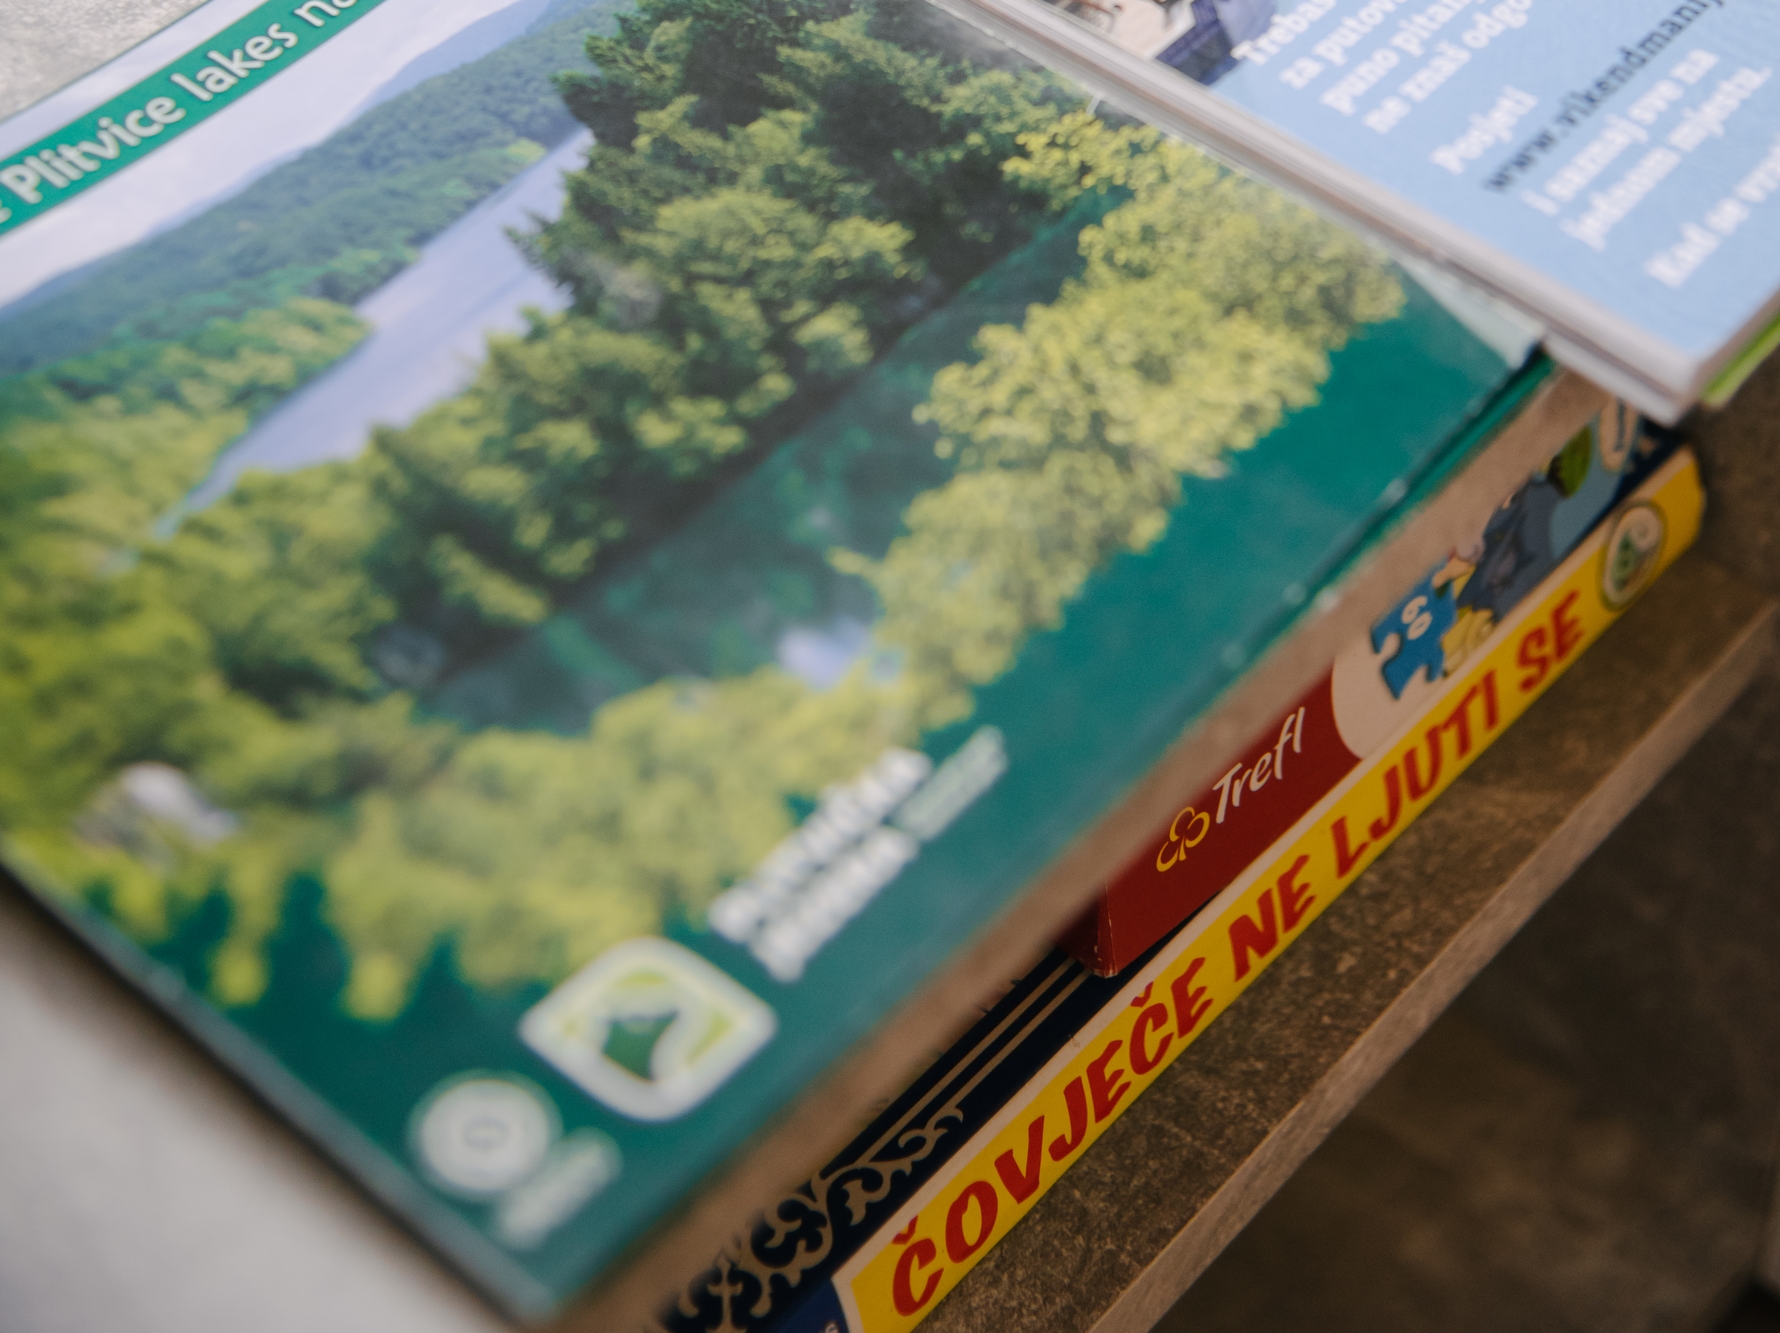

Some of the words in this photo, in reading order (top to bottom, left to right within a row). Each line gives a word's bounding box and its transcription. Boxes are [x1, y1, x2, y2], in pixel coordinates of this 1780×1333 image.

[0, 96, 187, 204] Plitvice
[170, 22, 299, 102] lakes
[1321, 46, 1400, 118] puno
[1212, 705, 1306, 824] Trefl
[892, 956, 1214, 1317] ČOVJEČE
[1228, 854, 1318, 983] NE
[1331, 668, 1499, 880] LJUTI
[1516, 588, 1585, 694] SE
